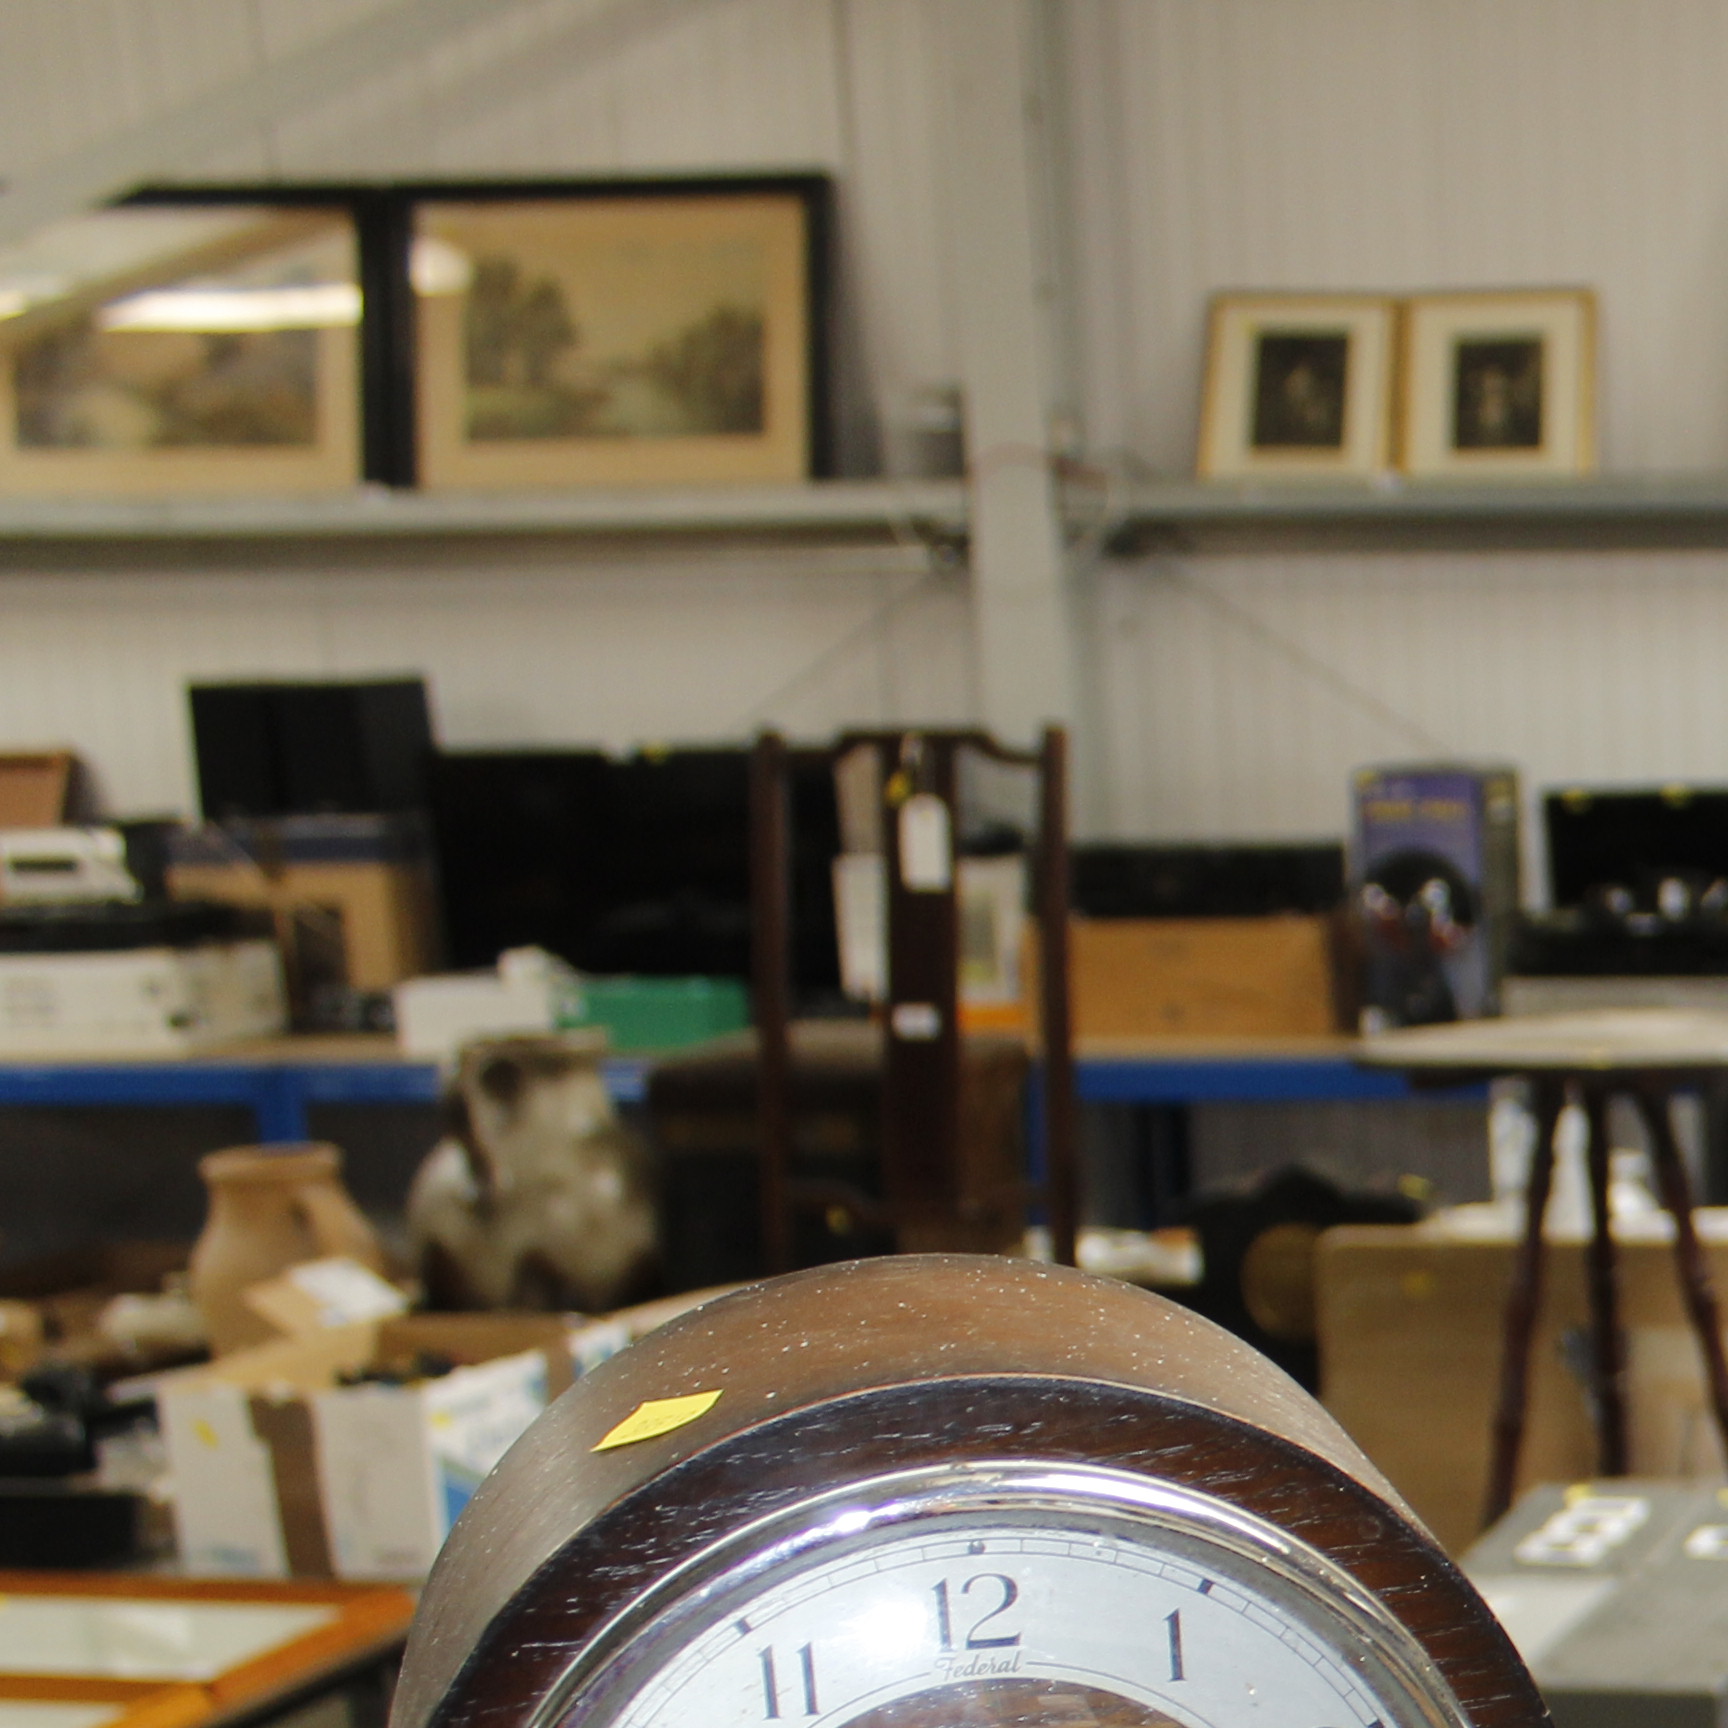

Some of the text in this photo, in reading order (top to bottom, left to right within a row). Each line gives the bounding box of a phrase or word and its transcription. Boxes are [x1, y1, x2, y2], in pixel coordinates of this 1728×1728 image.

[931, 1573, 1022, 1652] 12
[1163, 1609, 1187, 1682] 1
[758, 1643, 820, 1721] 11
[934, 1651, 1022, 1681] Federal
